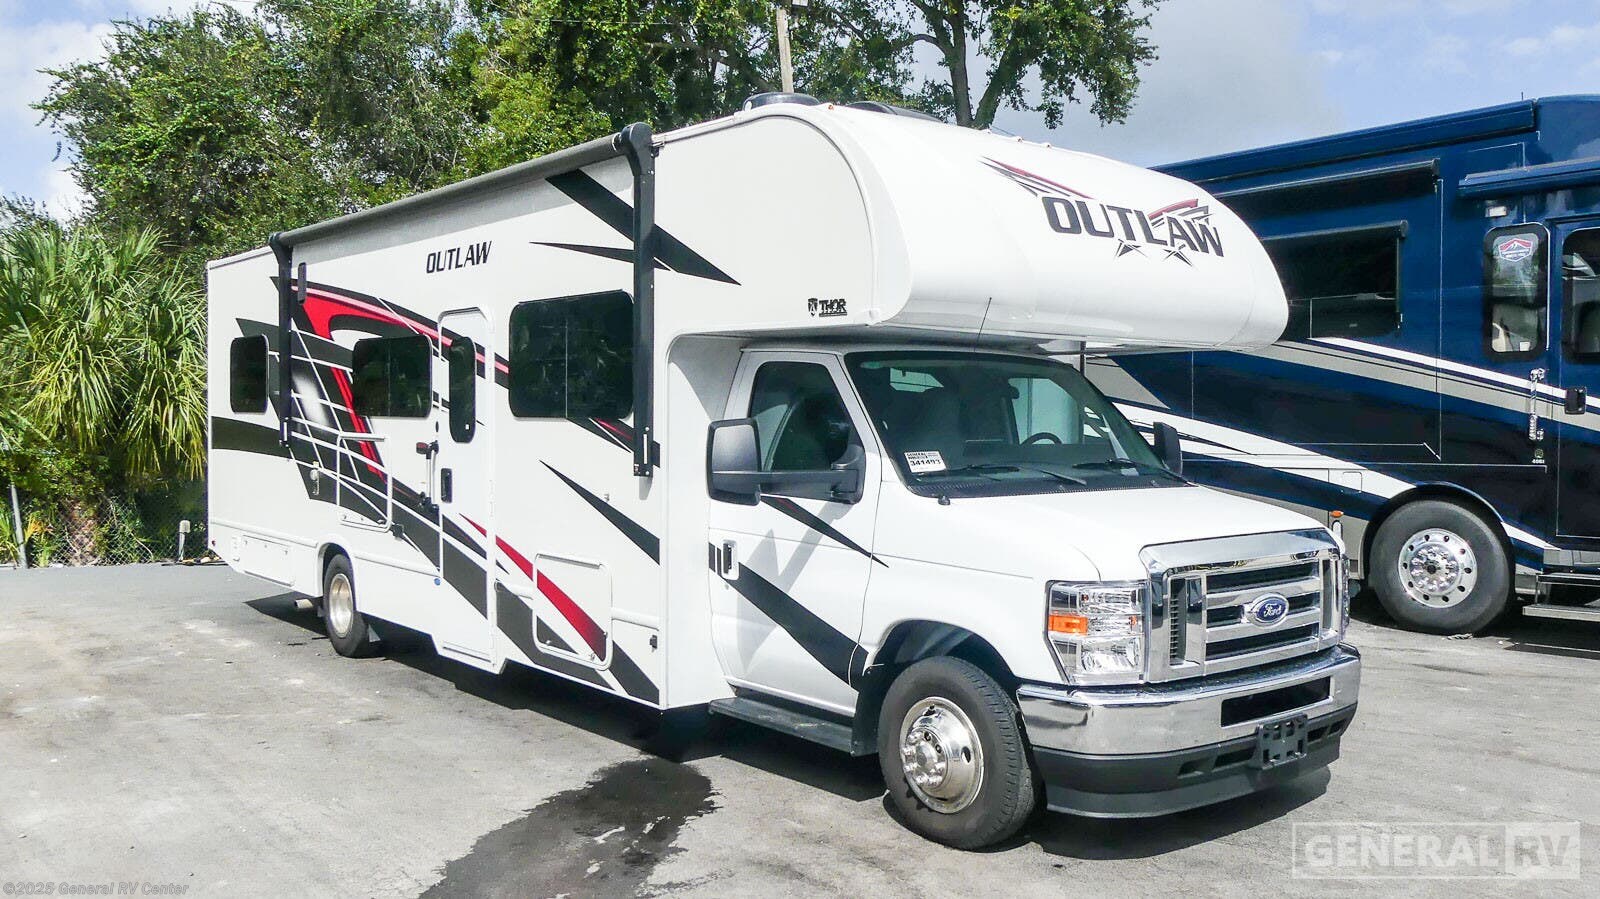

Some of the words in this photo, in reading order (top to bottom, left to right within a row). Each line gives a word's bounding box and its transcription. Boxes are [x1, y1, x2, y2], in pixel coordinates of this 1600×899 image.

[1041, 196, 1224, 257] OUTLAW
[426, 240, 492, 274] OUTLAW
[818, 298, 848, 313] THOR
[1263, 603, 1282, 618] Ford
